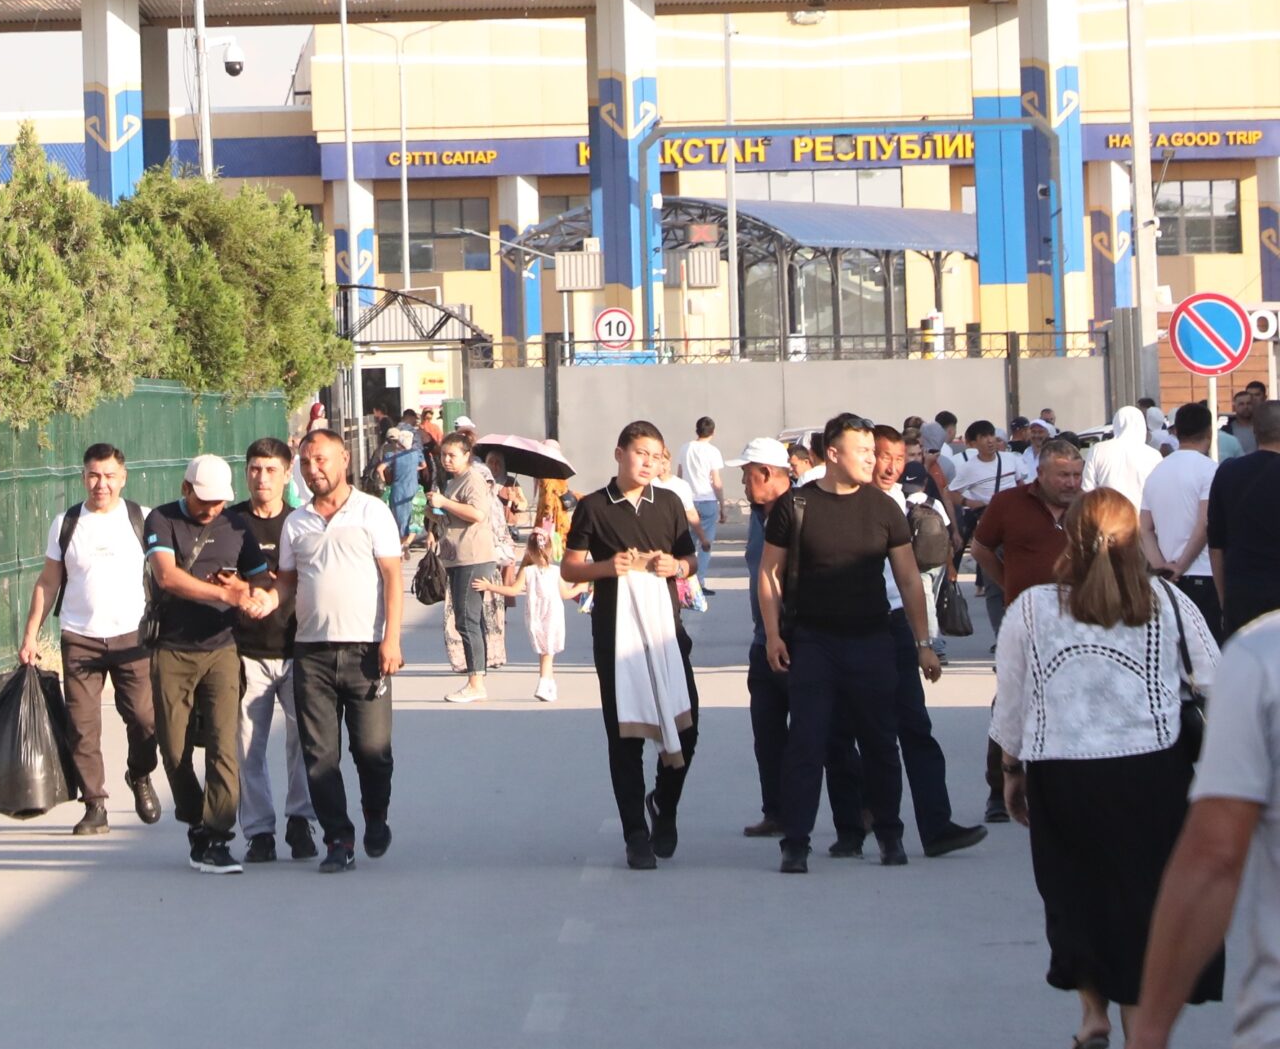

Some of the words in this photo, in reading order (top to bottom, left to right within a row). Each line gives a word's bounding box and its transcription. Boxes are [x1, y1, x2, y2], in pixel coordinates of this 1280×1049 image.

[1156, 133, 1169, 147] A
[1171, 131, 1220, 146] GOOD
[1226, 130, 1263, 145] TRIP
[441, 149, 497, 165] САПАР
[605, 320, 627, 337] 10
